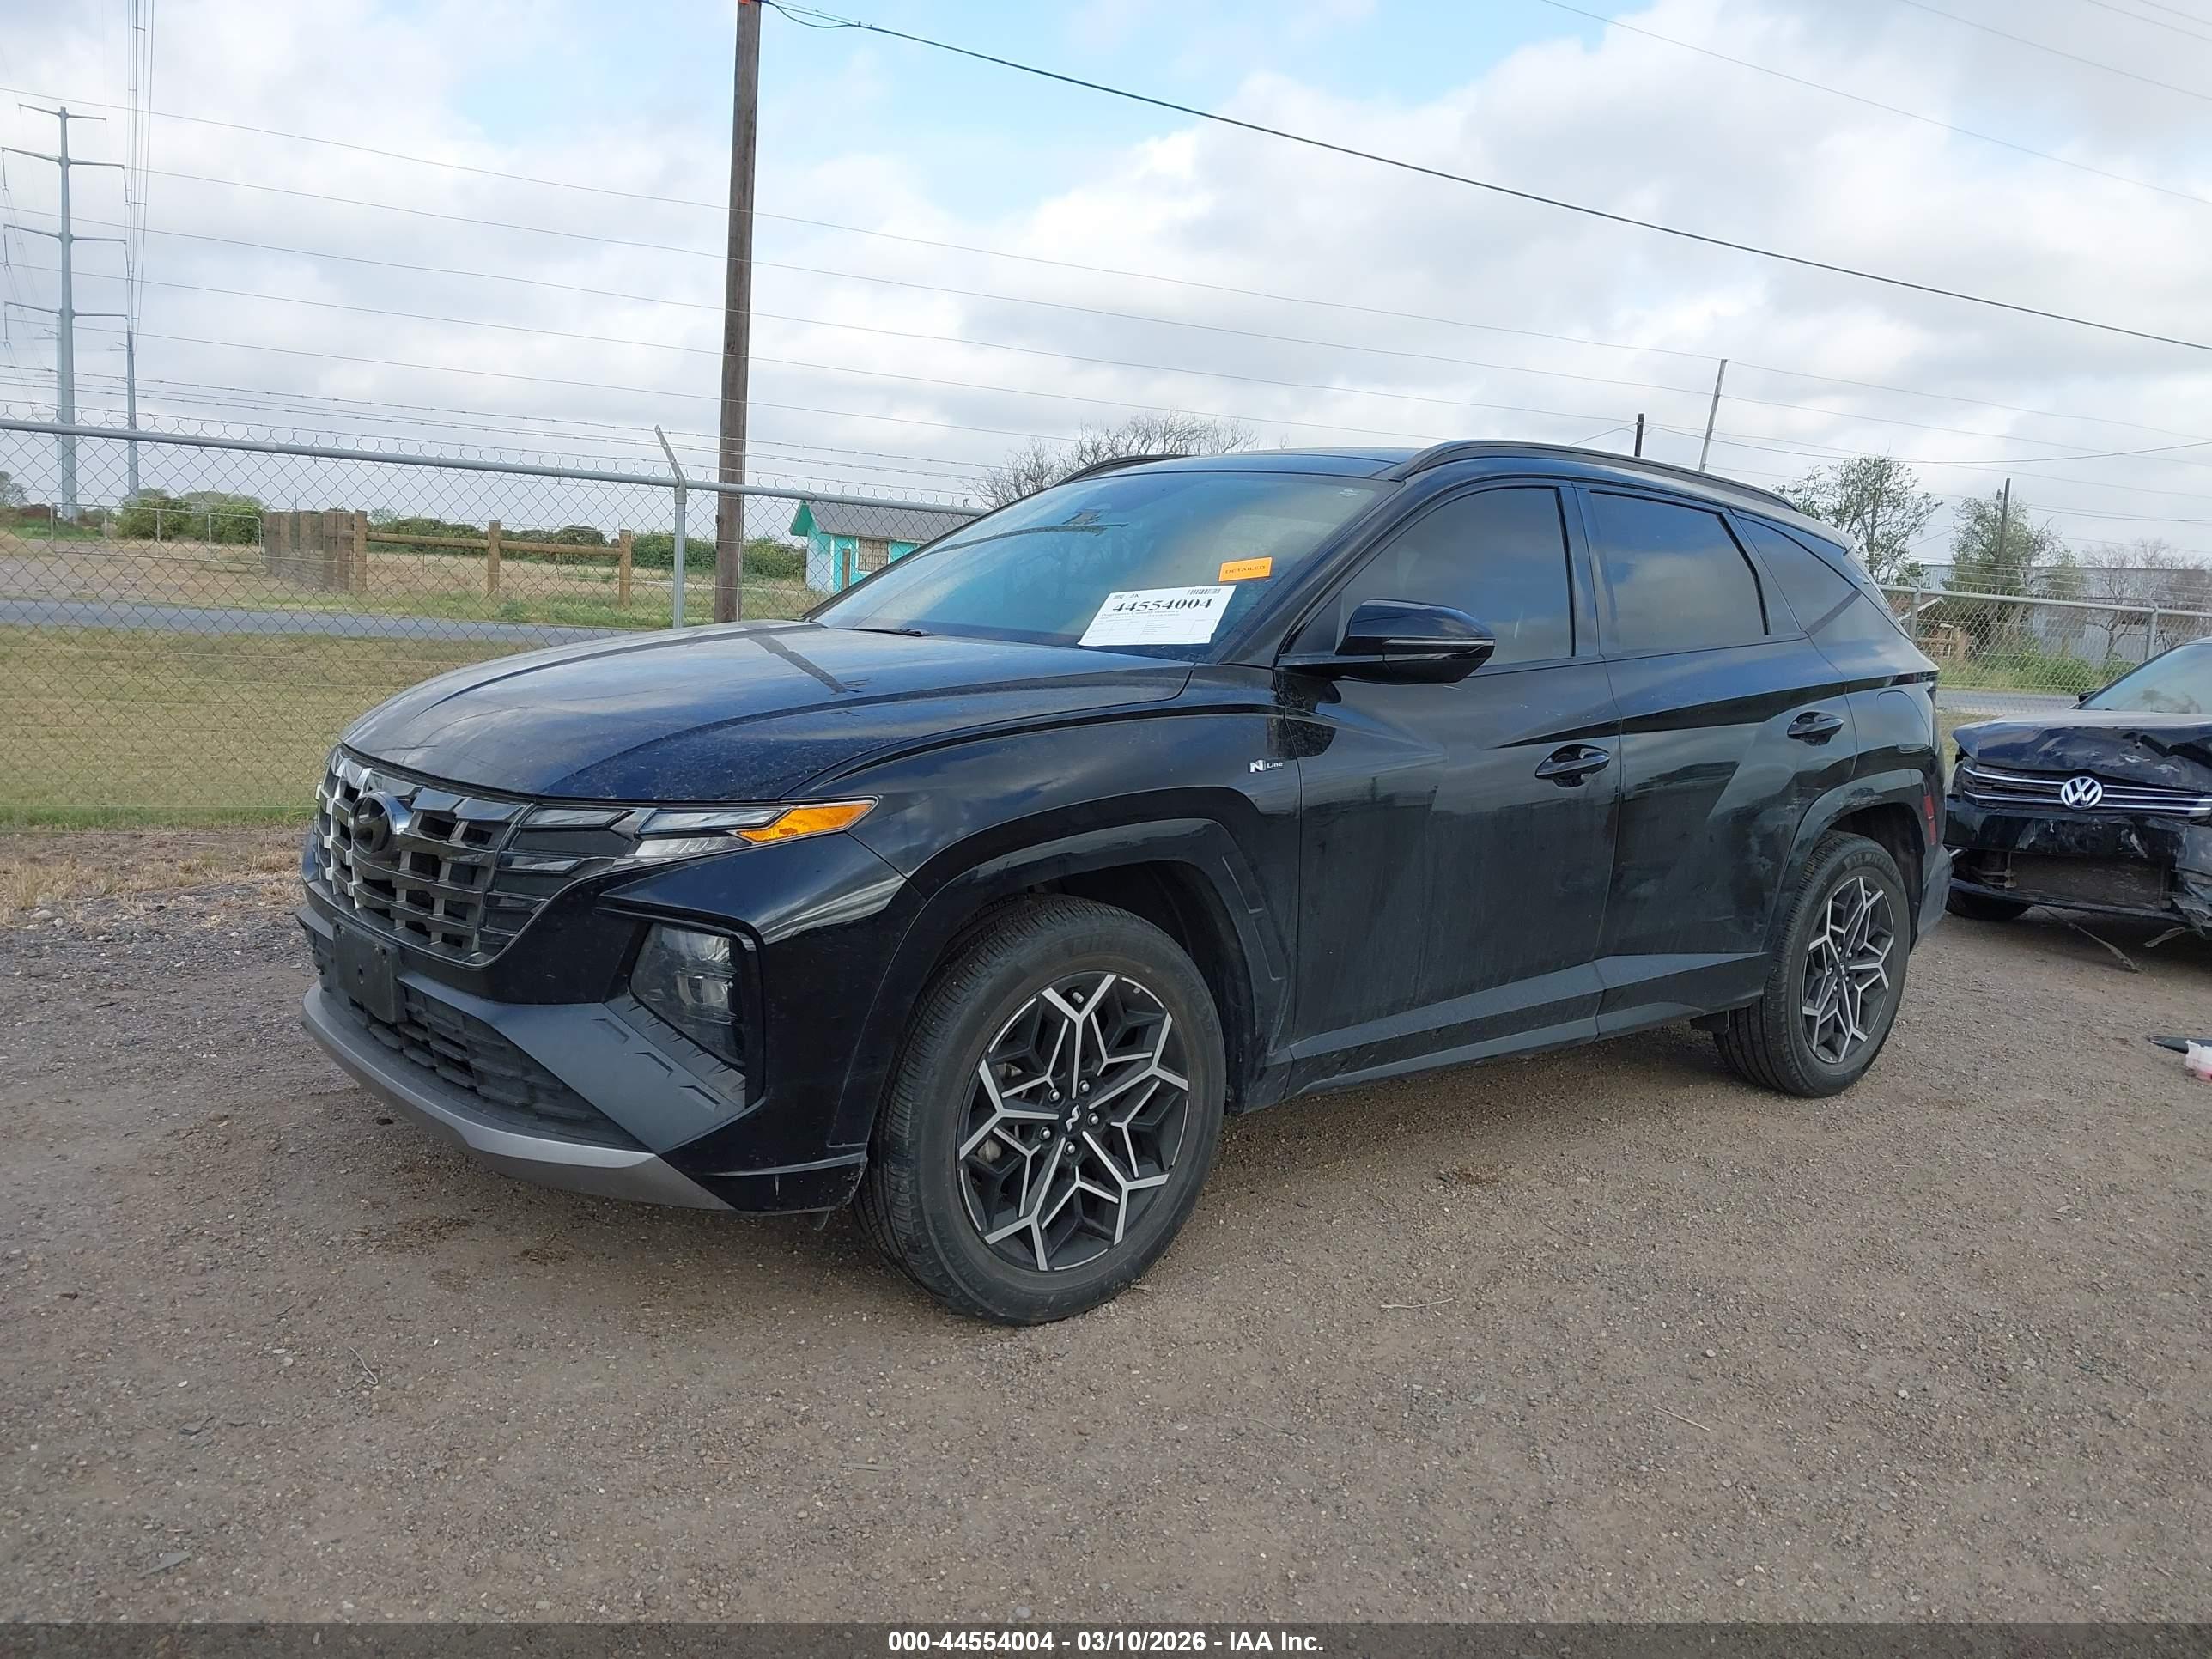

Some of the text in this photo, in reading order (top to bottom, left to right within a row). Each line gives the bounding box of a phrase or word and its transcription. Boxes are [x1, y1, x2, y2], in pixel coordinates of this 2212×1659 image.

[1225, 565, 1265, 574] DETAILED
[1113, 598, 1213, 611] 44554004
[1249, 760, 1266, 773] N
